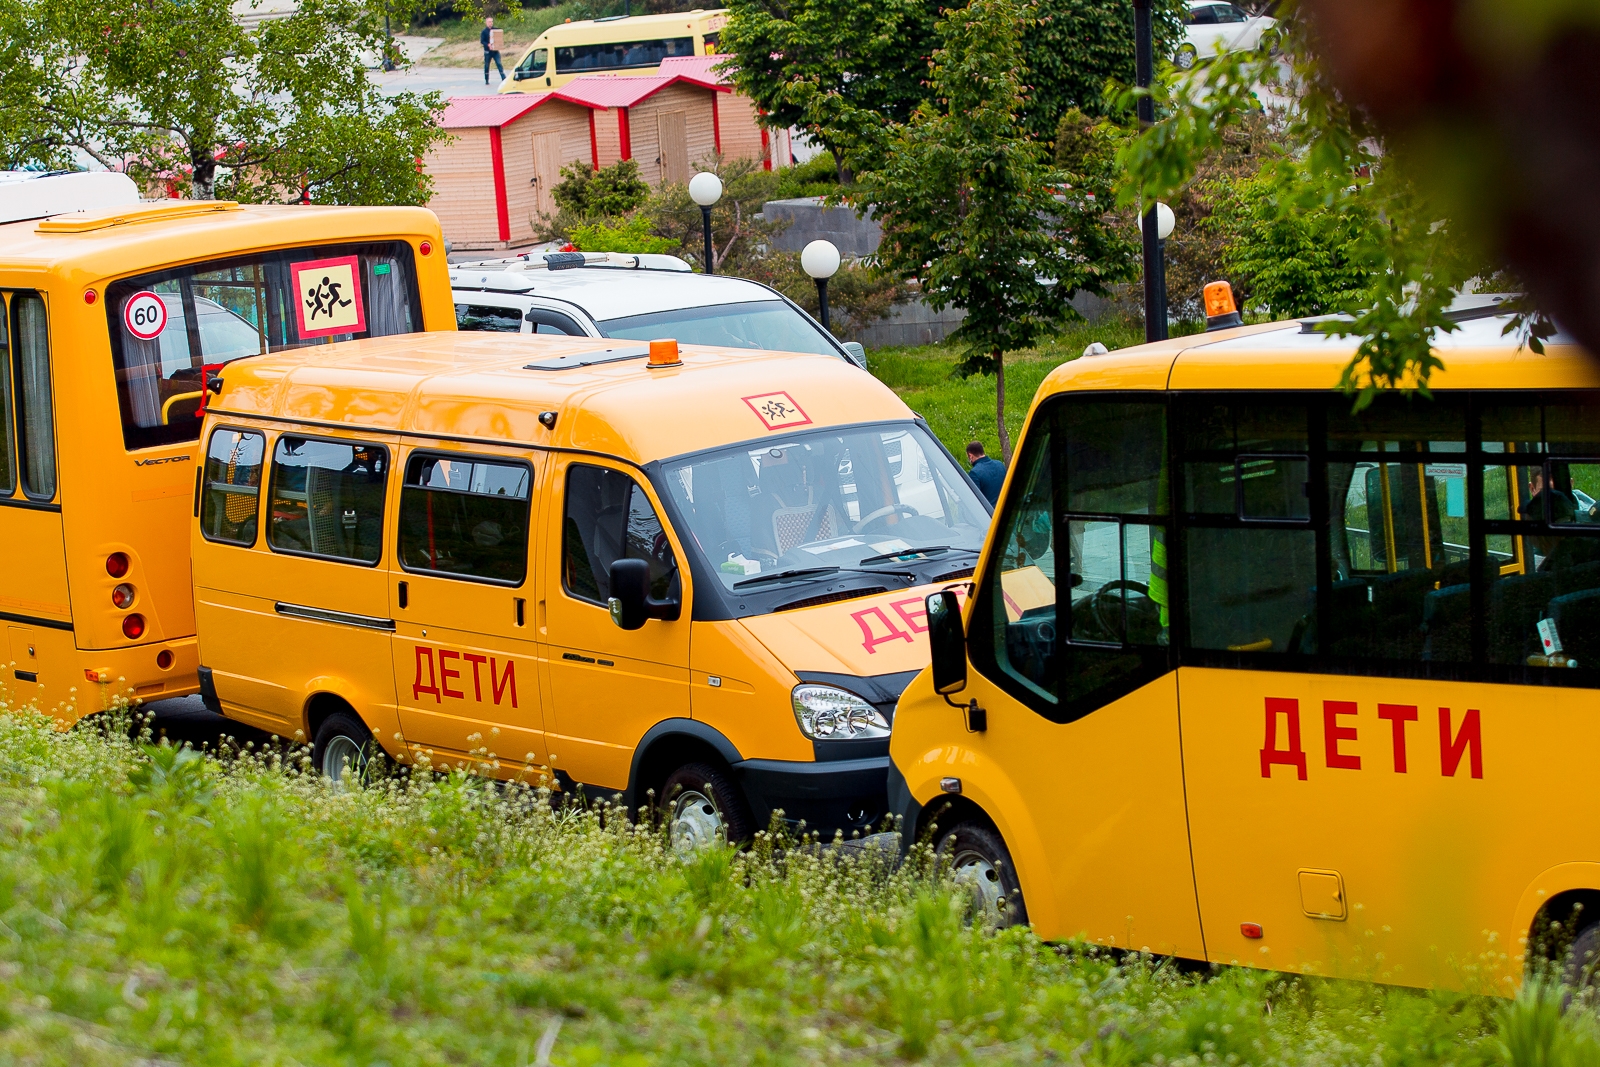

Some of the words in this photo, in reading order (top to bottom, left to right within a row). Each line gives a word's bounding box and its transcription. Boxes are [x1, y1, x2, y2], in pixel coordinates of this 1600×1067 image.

[135, 305, 157, 325] 60
[413, 645, 518, 709] ДЕТИ
[1260, 697, 1483, 780] ДЕТИ
